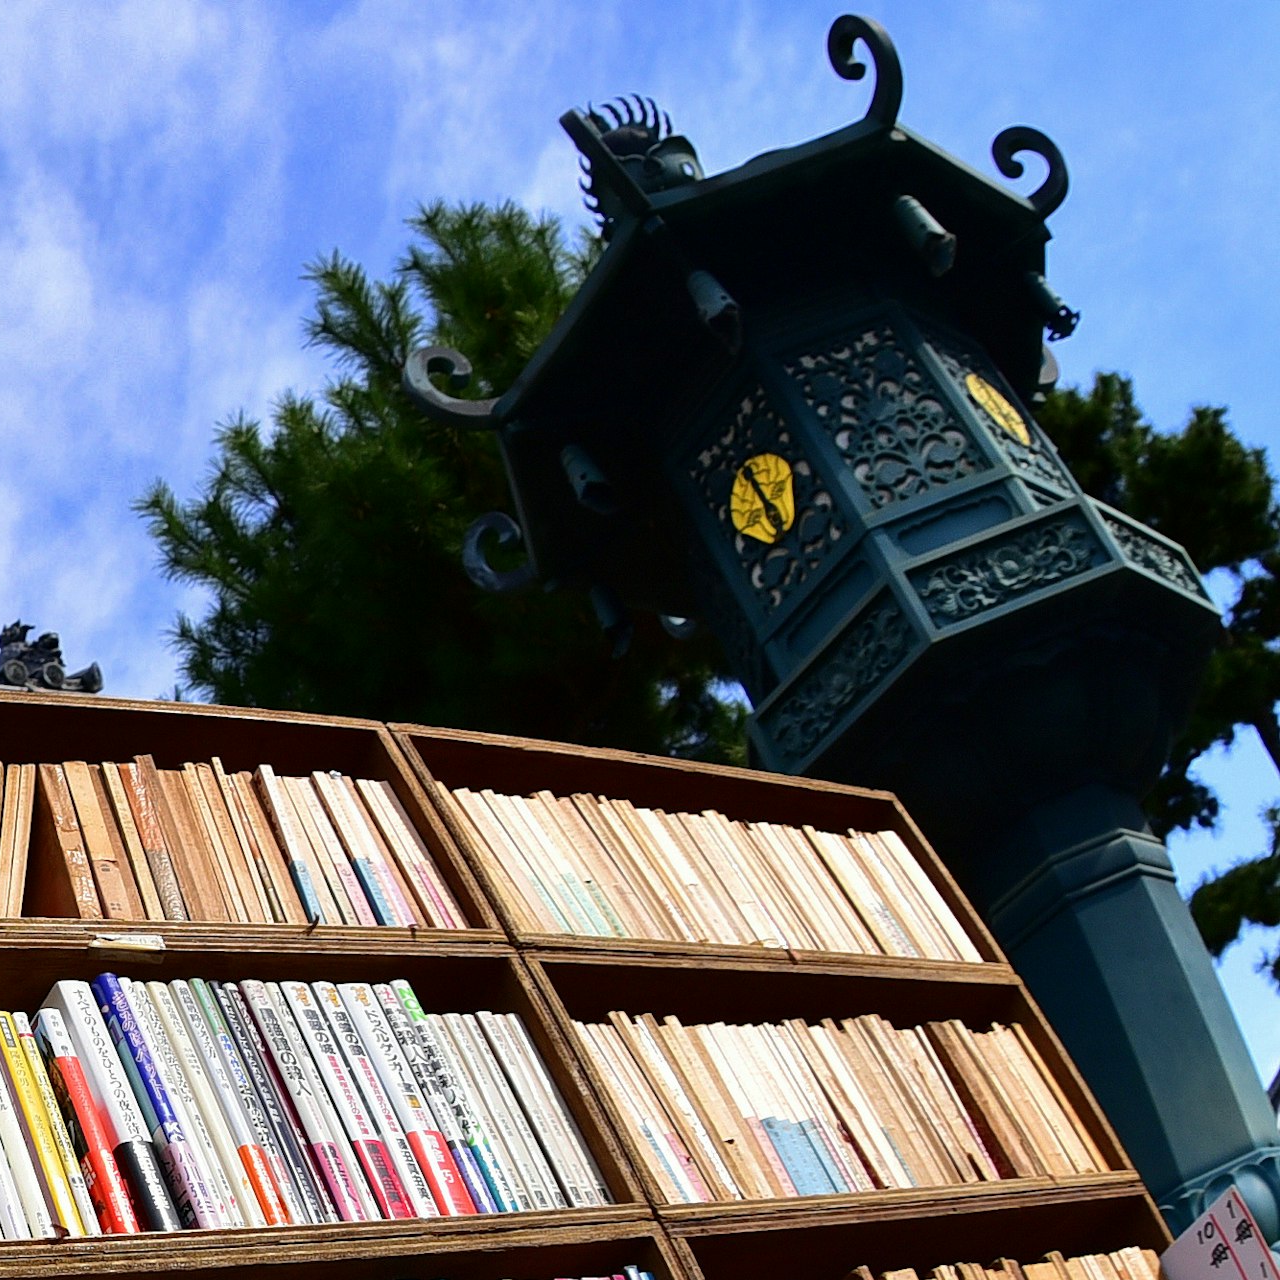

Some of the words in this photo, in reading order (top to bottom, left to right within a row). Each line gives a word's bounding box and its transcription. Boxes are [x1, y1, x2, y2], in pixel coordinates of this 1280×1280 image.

[74, 989, 143, 1142] すべてのものをひとつの夜が待つ
